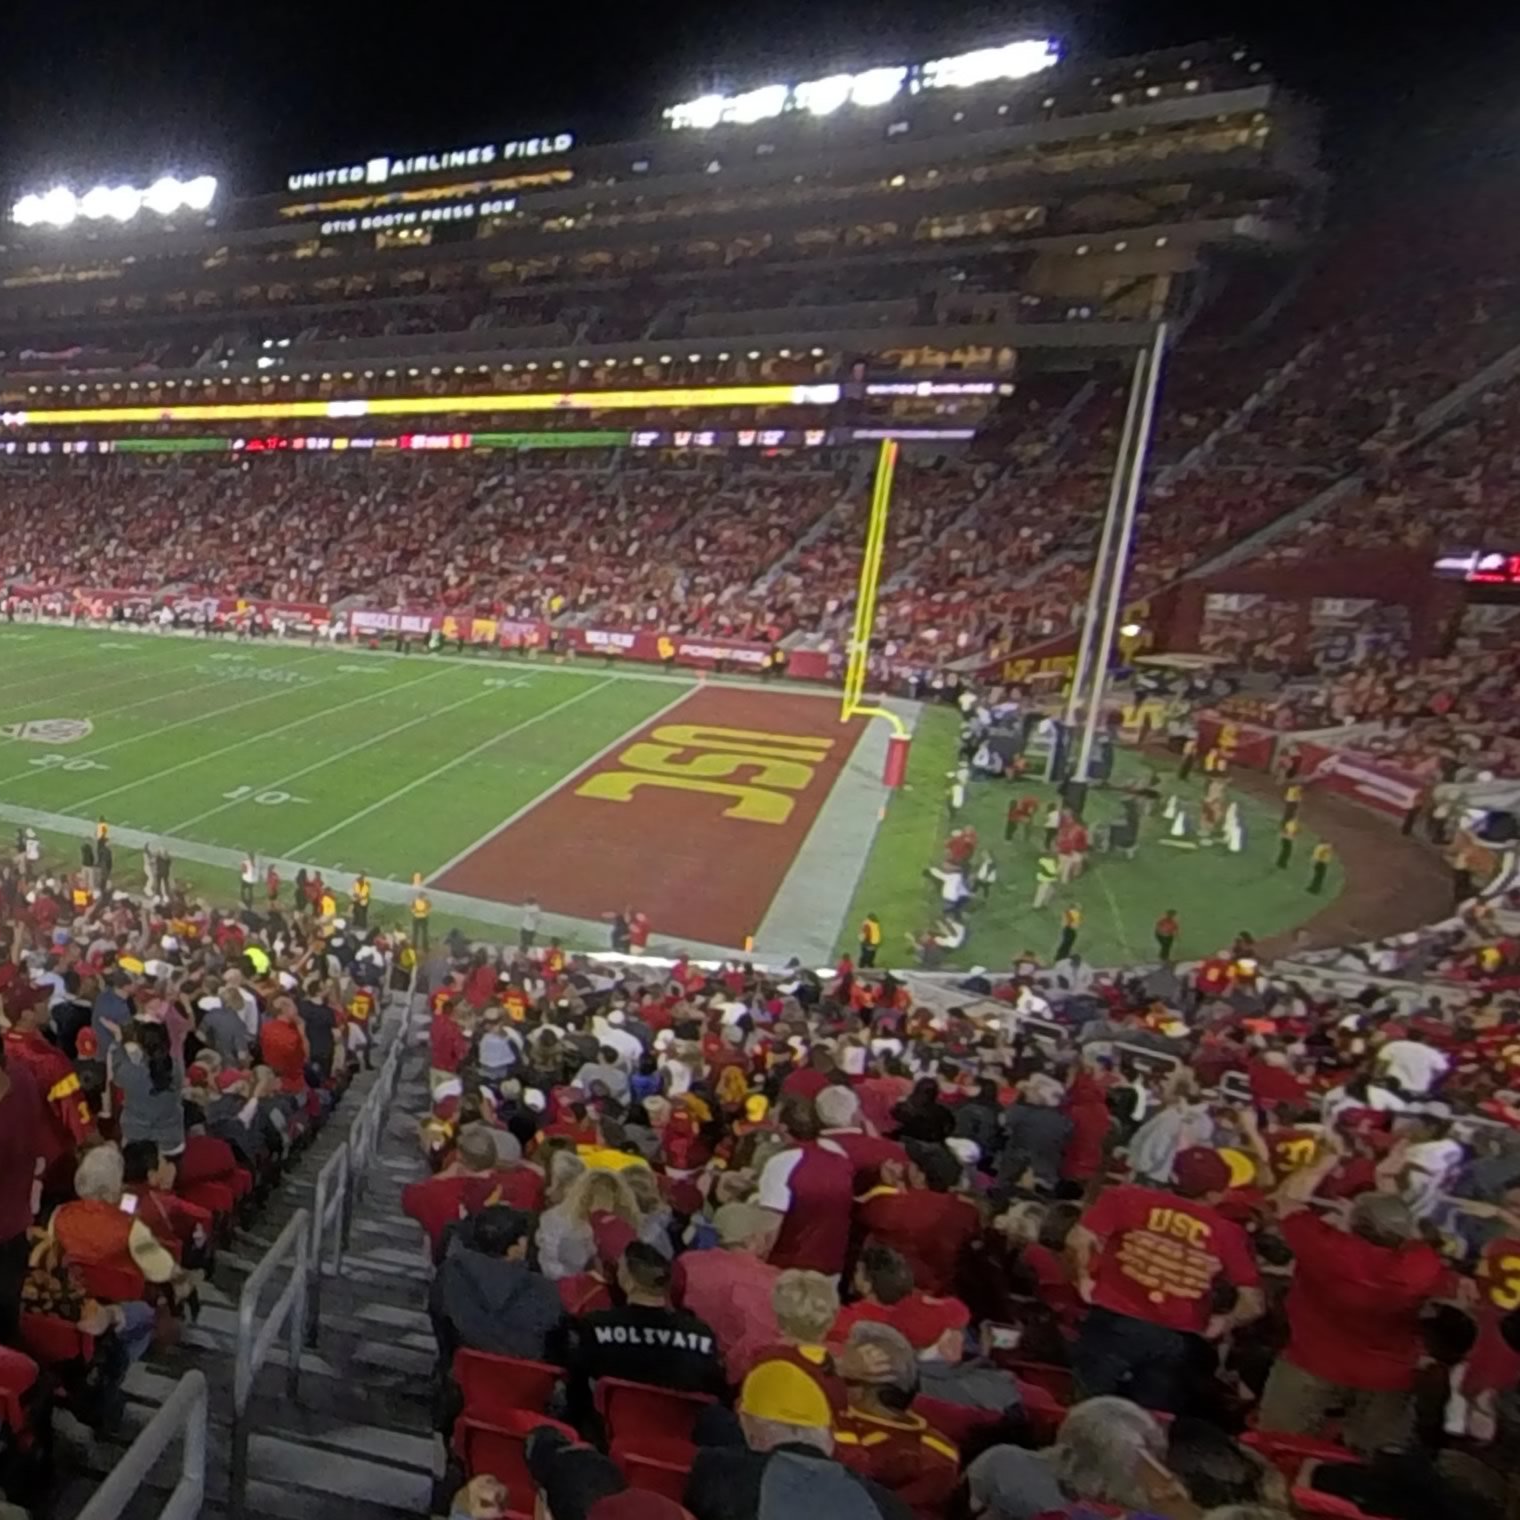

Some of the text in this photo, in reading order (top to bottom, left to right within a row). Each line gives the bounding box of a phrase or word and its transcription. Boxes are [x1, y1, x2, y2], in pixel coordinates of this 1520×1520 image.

[288, 133, 573, 191] UNITED AIRLINES FIELD
[421, 203, 475, 223] PRESS
[574, 724, 836, 824] USC
[1146, 1207, 1212, 1250] USC
